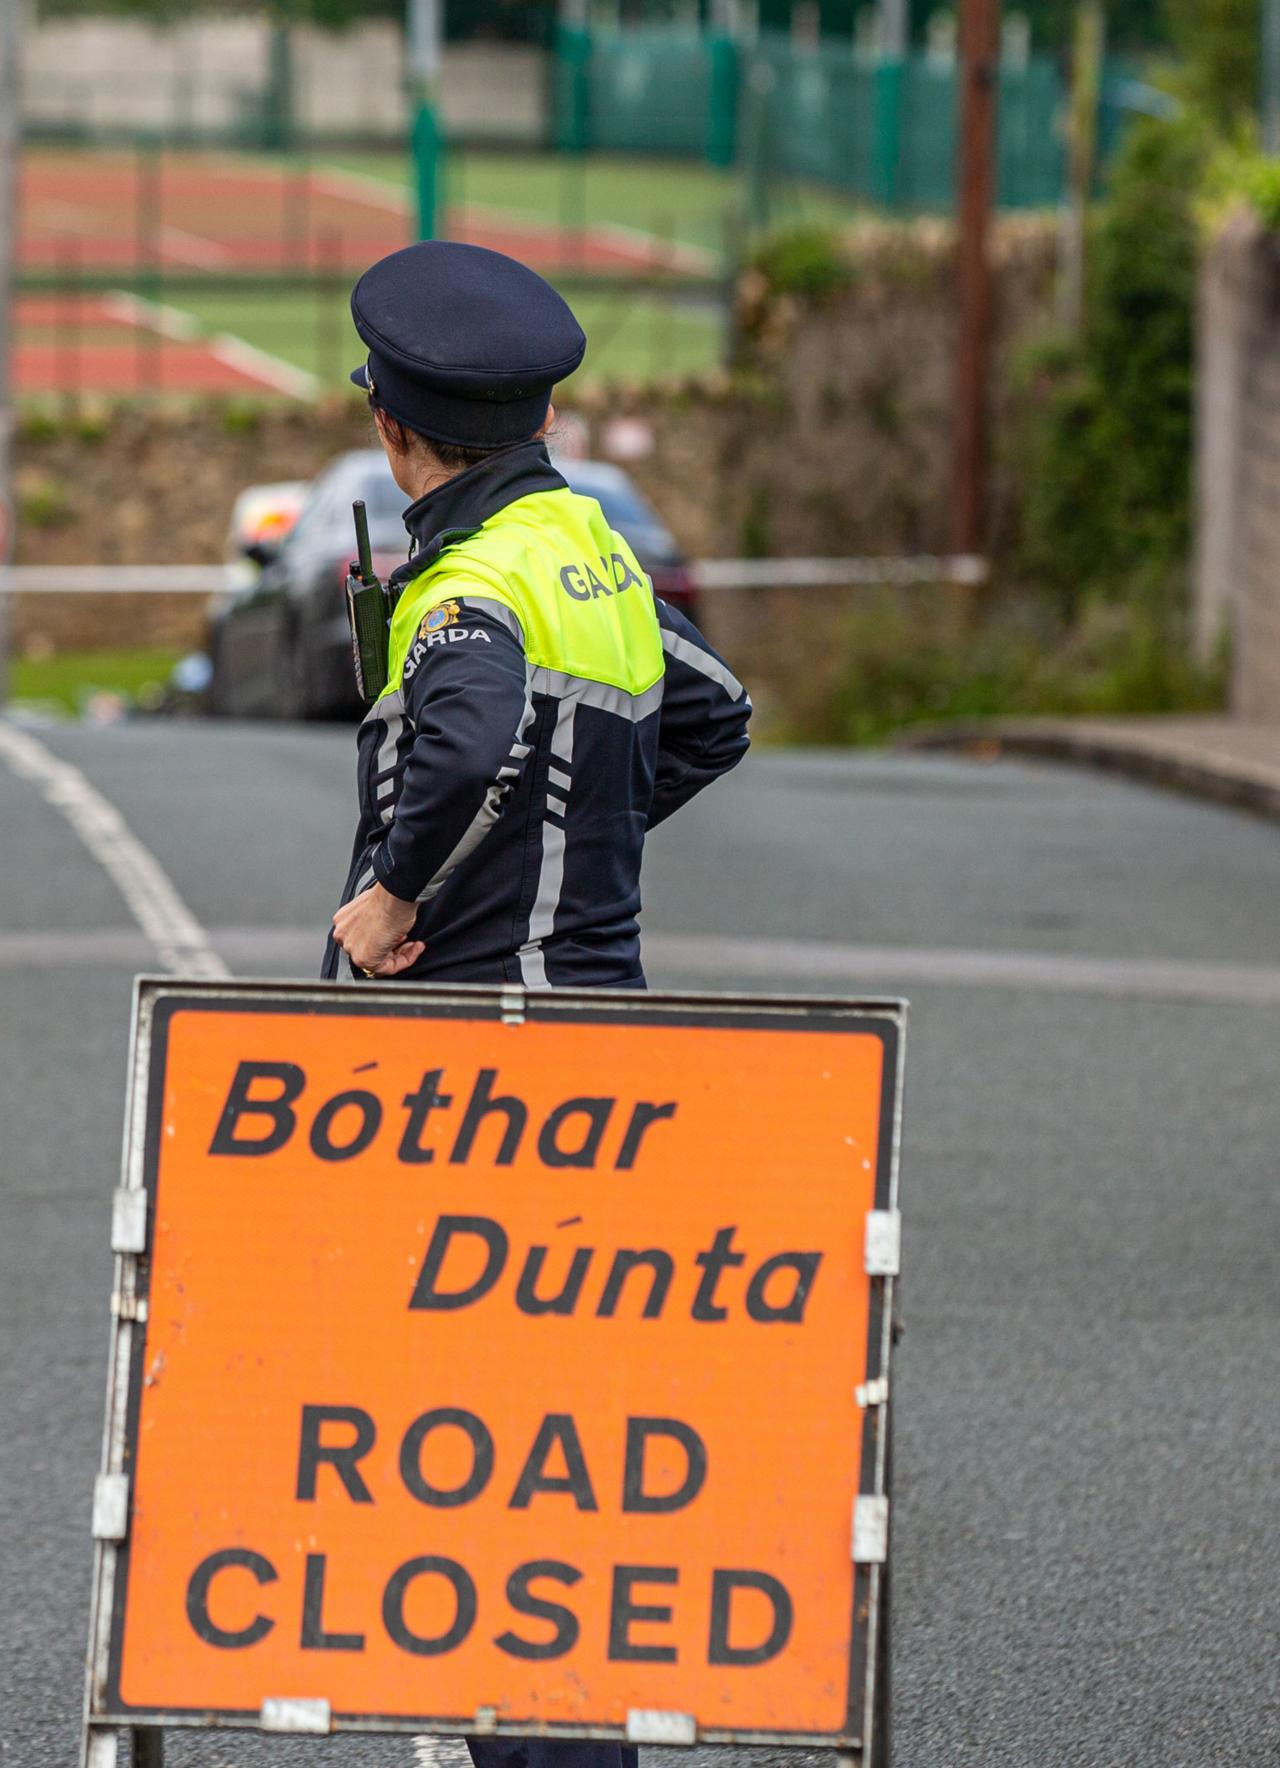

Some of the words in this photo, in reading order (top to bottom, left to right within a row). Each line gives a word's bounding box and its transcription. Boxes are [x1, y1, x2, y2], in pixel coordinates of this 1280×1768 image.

[559, 552, 643, 602] GADA
[207, 1061, 677, 1169] Bóthar
[408, 1215, 824, 1324] Dúnta
[296, 1404, 708, 1513] ROAD
[186, 1548, 794, 1666] CLOSED
